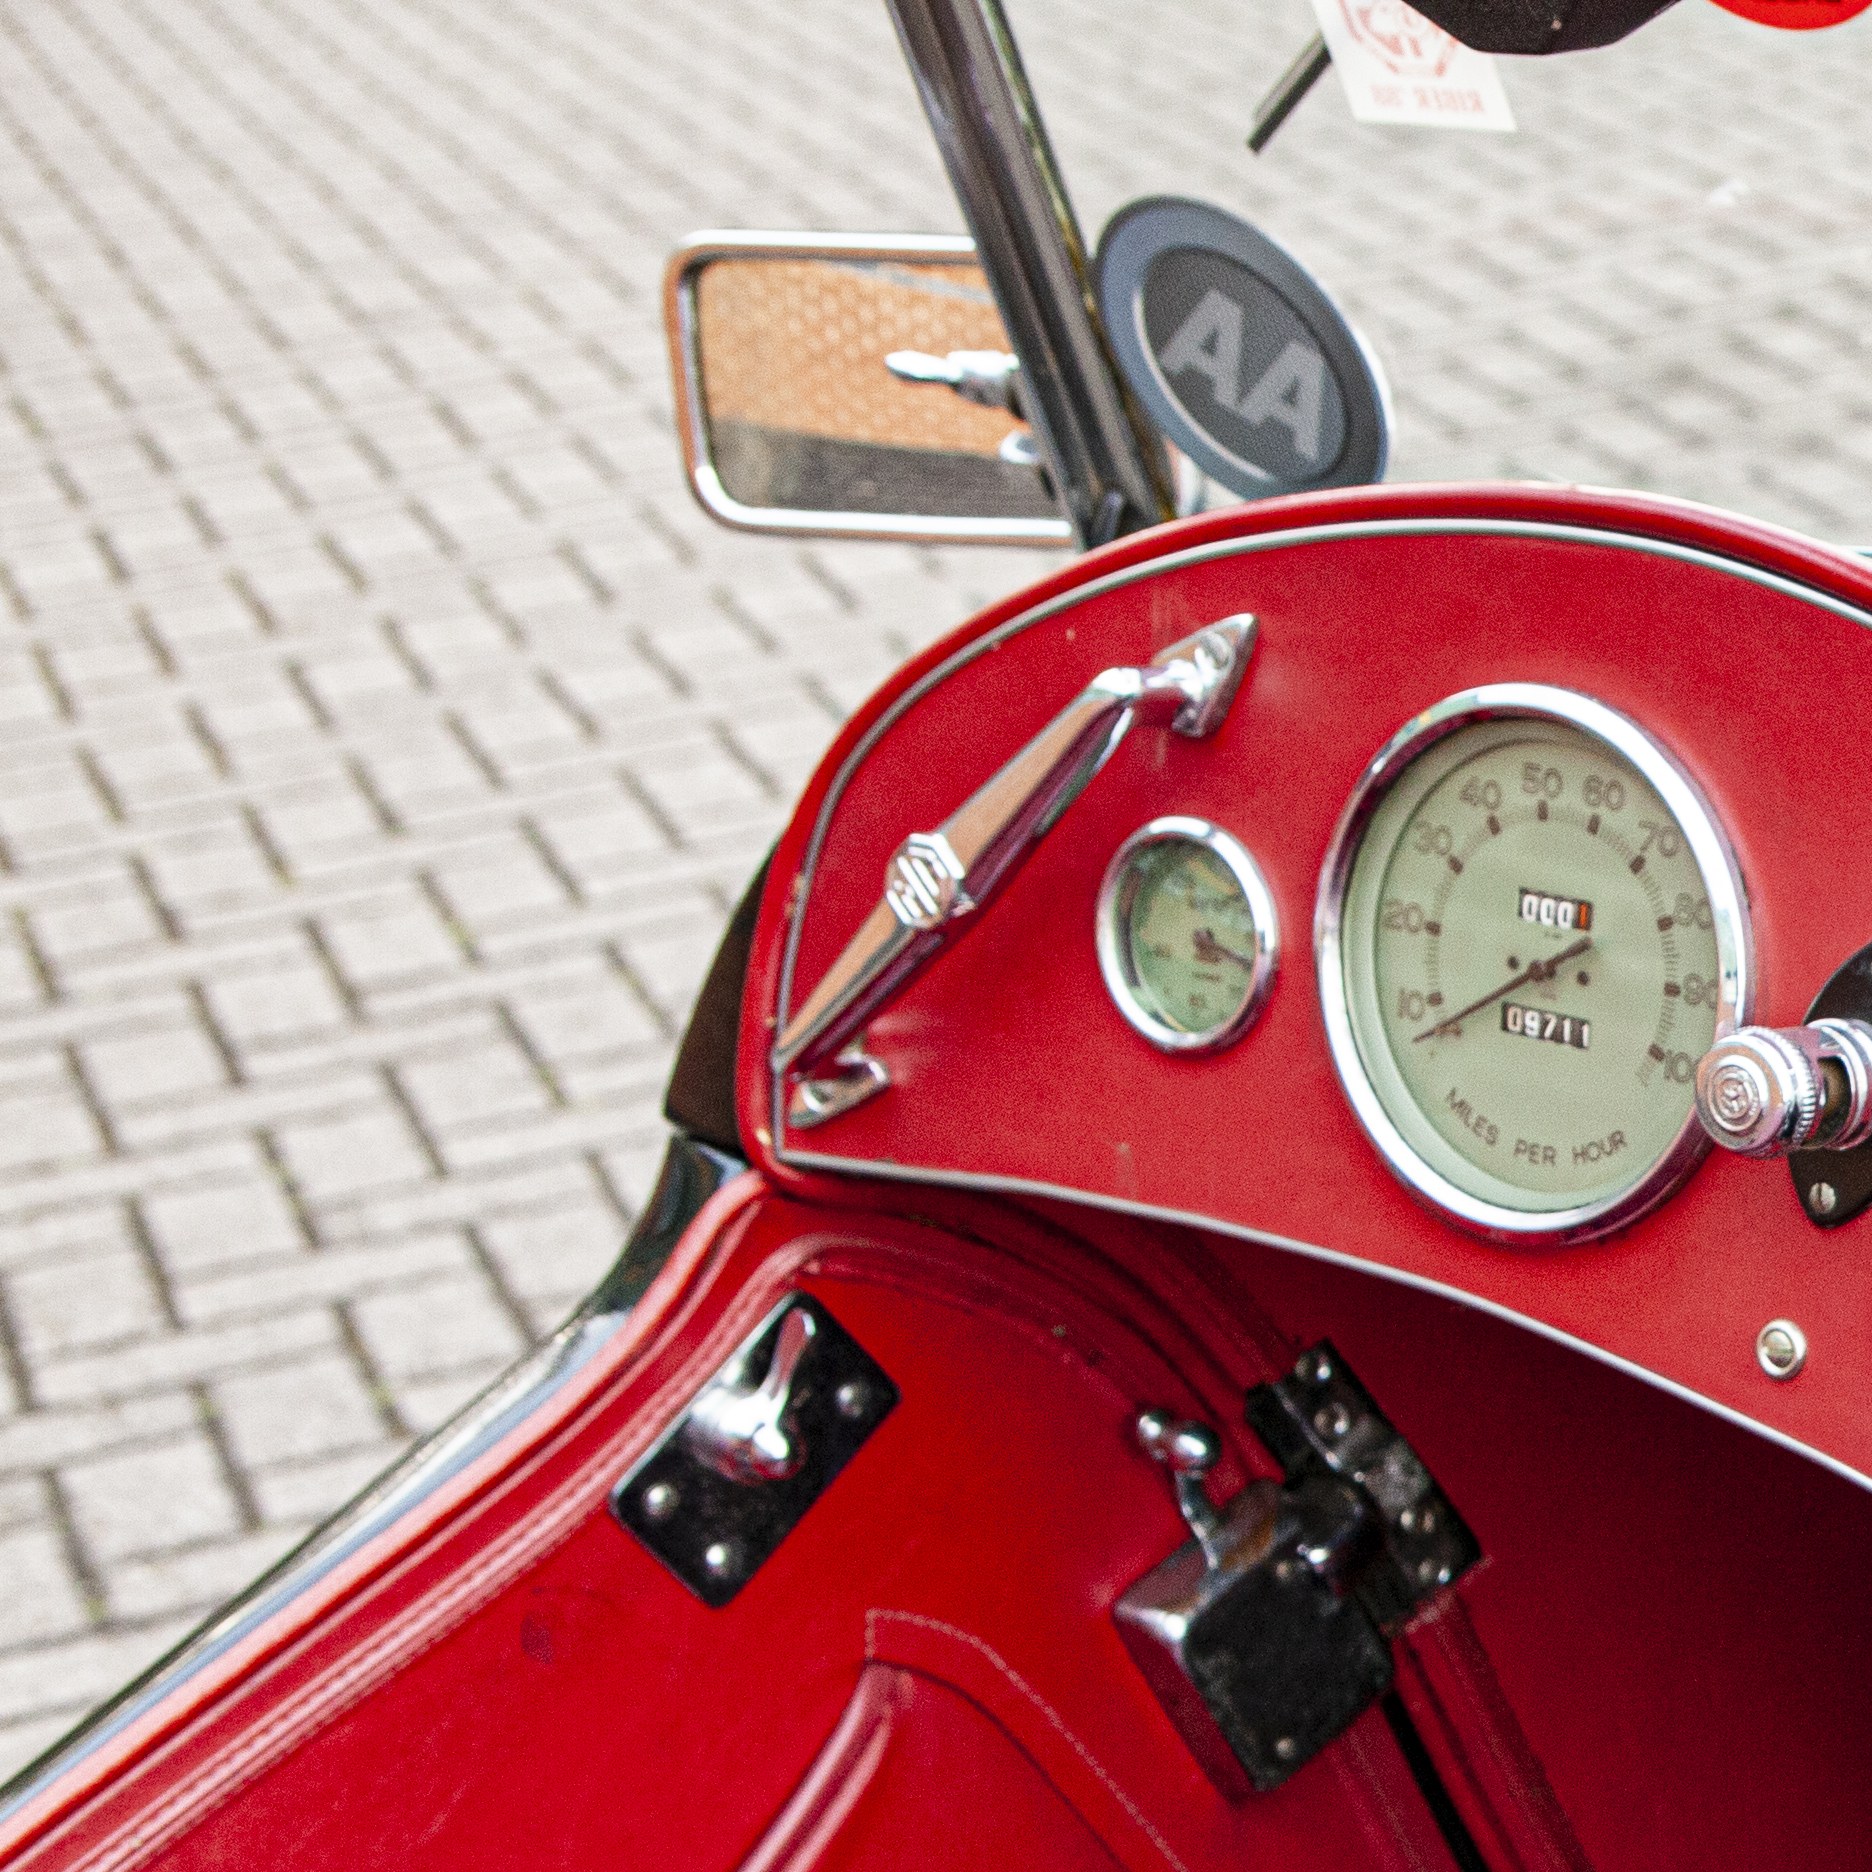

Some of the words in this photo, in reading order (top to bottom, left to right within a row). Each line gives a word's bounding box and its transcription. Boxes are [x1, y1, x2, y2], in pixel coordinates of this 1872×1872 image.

[1159, 290, 1325, 463] AA
[1458, 774, 1503, 812] 40
[1521, 760, 1564, 800] 50
[1581, 772, 1628, 812] 60
[1411, 821, 1454, 856] 30
[1638, 817, 1682, 858] 70
[1382, 898, 1427, 935] 20
[1398, 986, 1426, 1021] 10
[1504, 1003, 1590, 1049] 09711
[1446, 1086, 1500, 1147] MILES
[1512, 1136, 1557, 1169] PER
[1571, 1128, 1627, 1164] HOUR
